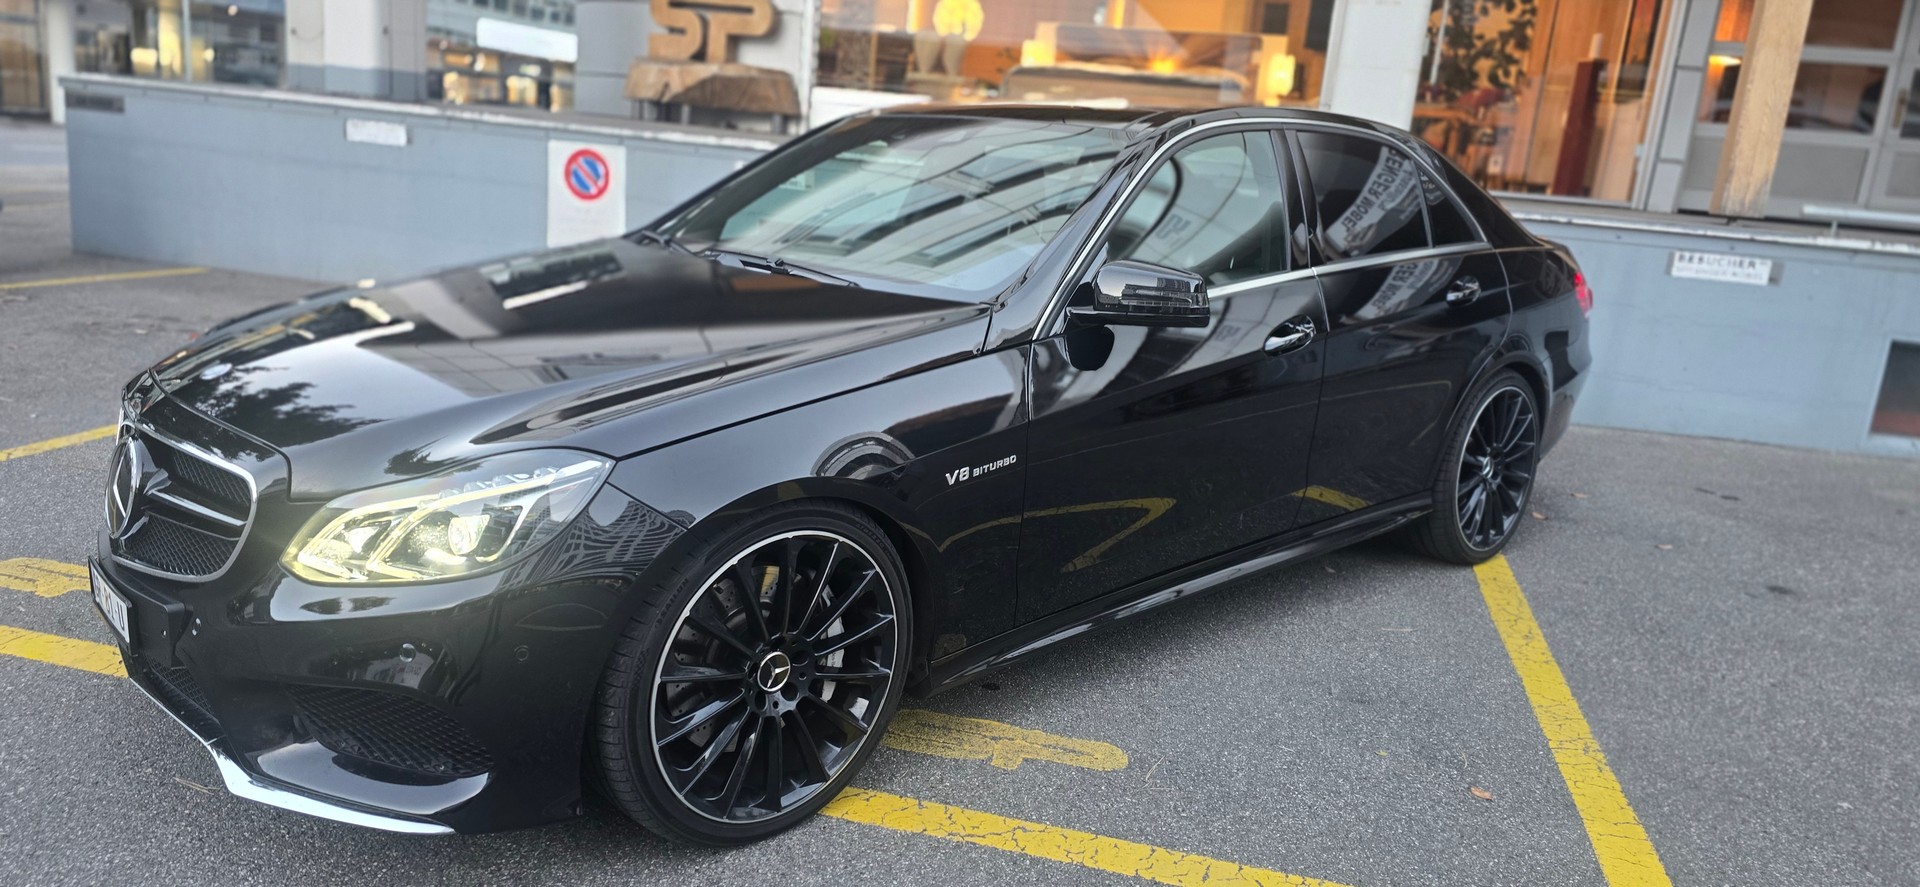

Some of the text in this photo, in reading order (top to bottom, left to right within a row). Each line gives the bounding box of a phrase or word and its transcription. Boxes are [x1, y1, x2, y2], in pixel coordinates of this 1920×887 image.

[647, 0, 773, 62] SP
[1677, 253, 1757, 270] BESUCHER
[945, 454, 1017, 486] V8 BITURBO
